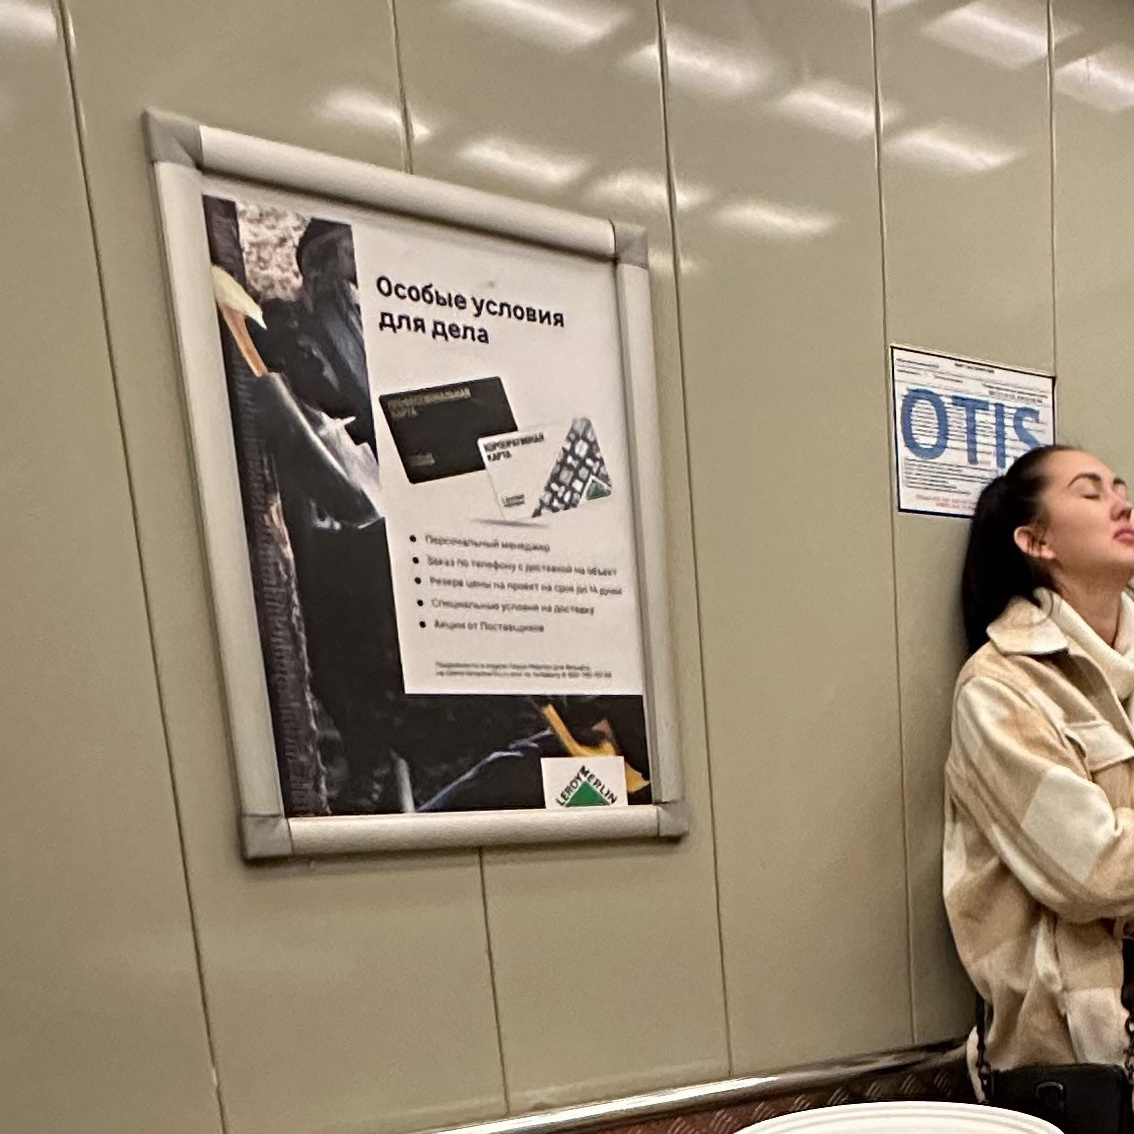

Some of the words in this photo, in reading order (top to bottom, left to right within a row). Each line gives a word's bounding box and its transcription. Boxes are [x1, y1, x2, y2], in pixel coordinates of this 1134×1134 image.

[376, 275, 467, 310] Особые
[471, 296, 565, 328] условия
[379, 311, 426, 334] для
[431, 319, 489, 344] дела
[900, 387, 1042, 470] OTIS
[555, 773, 583, 806] LEROY
[579, 764, 618, 805] MERLIN
